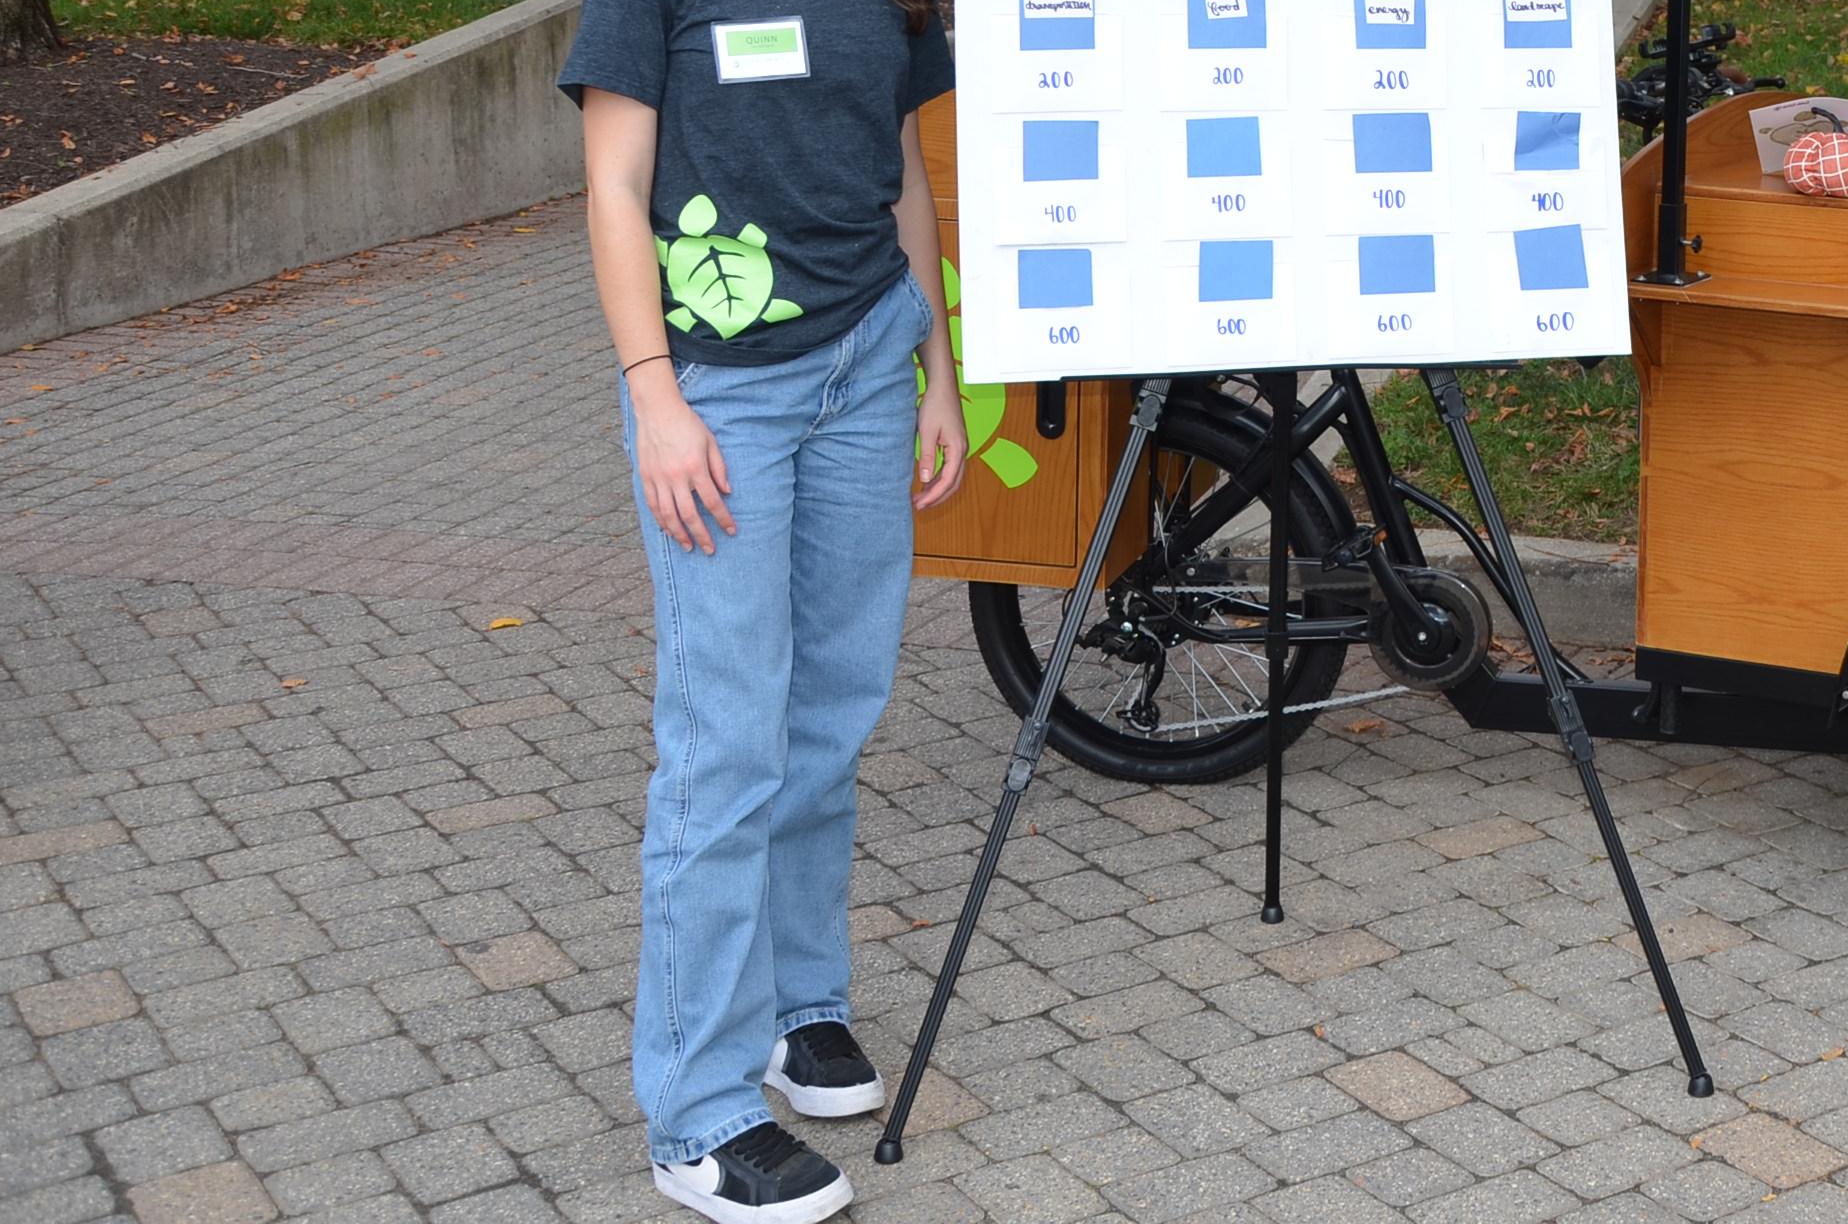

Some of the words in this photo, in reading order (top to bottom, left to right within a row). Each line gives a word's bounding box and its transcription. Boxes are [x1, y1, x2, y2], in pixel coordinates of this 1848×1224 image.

[1207, 0, 1240, 16] food
[1368, 5, 1410, 22] energy
[745, 35, 779, 45] QUINN
[1038, 71, 1074, 88] 200
[1212, 67, 1244, 85] 200
[1373, 69, 1409, 90] 200
[1526, 69, 1555, 88] 200
[1211, 194, 1246, 213] 400
[1373, 189, 1406, 209] 400
[1531, 192, 1564, 212] 400
[1045, 204, 1076, 223] 400
[1216, 317, 1247, 336] 600
[1378, 314, 1412, 332] 600
[1536, 312, 1574, 332] 600
[1049, 326, 1080, 345] 600
